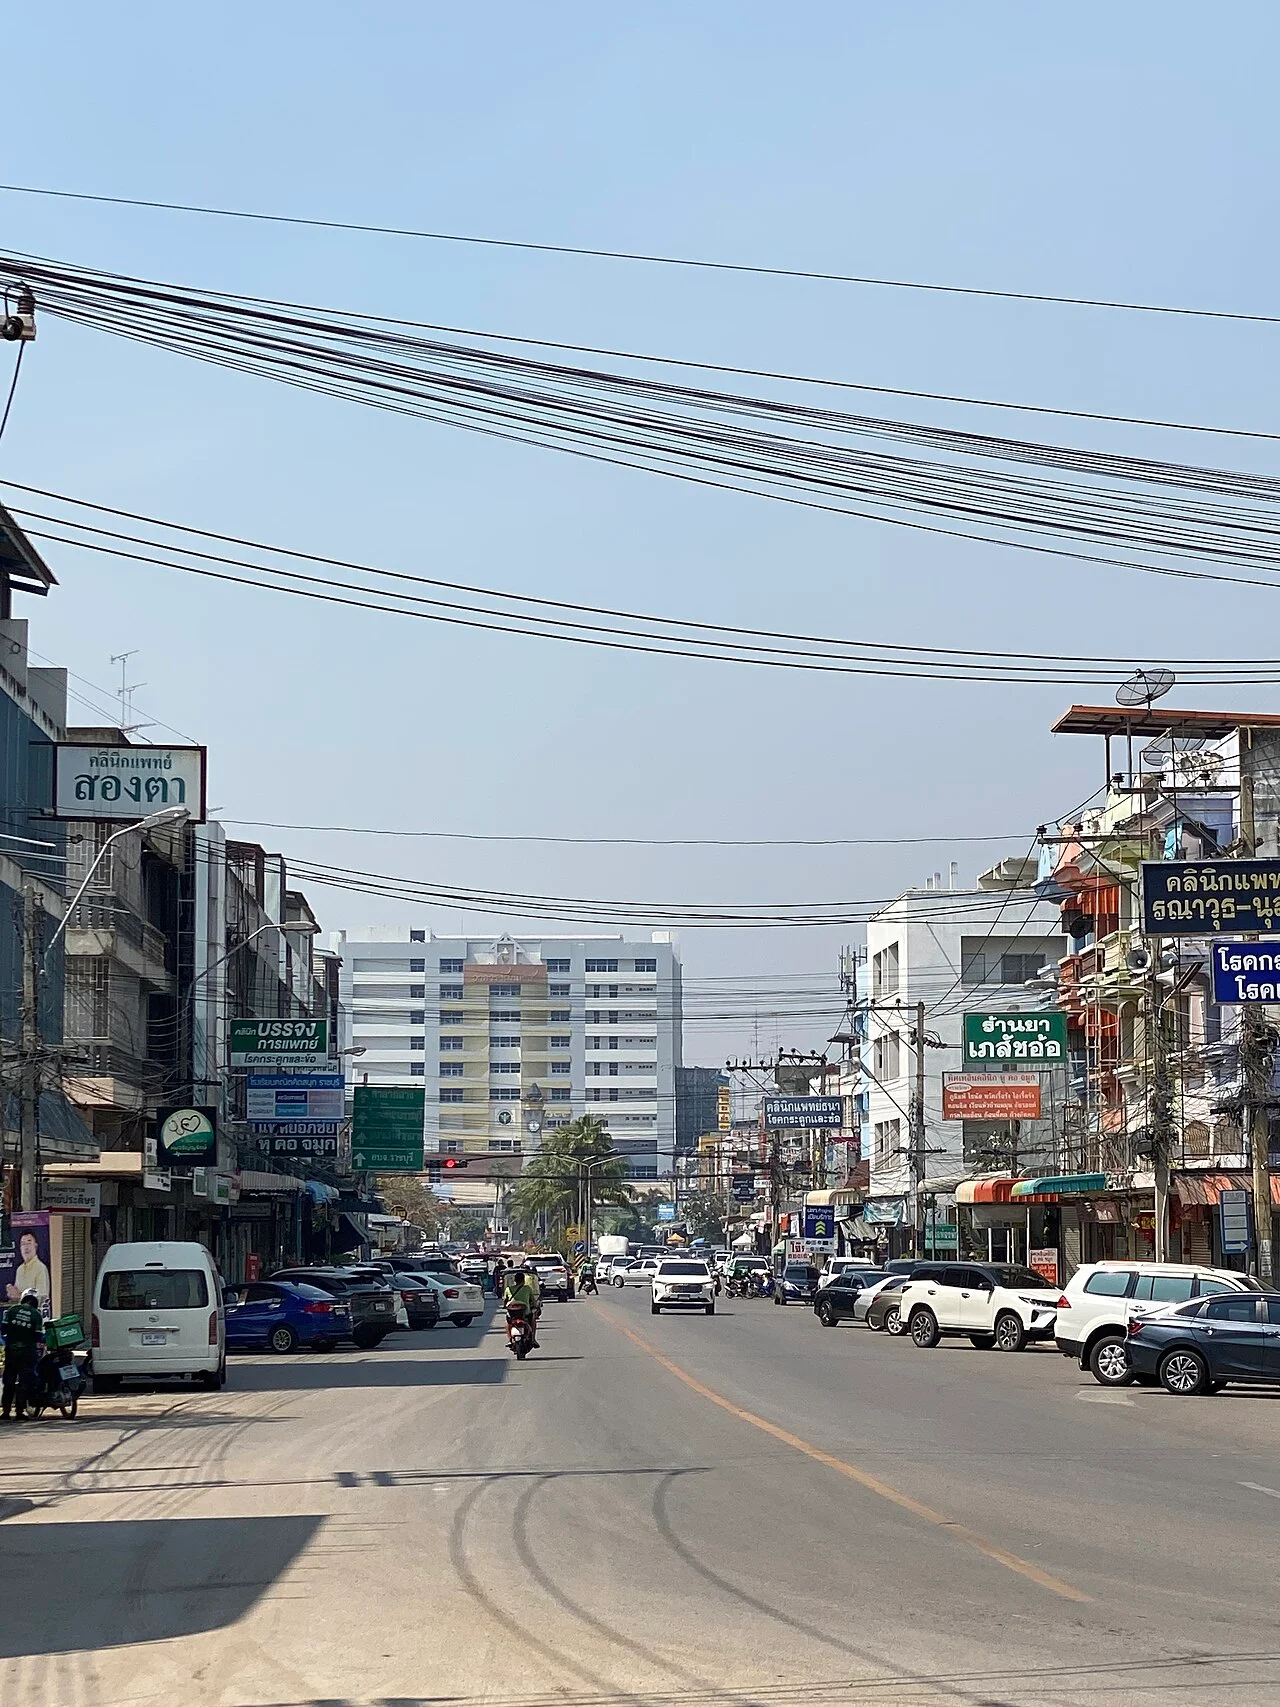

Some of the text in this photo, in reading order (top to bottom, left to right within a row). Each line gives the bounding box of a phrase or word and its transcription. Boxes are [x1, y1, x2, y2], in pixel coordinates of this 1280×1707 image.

[89, 751, 172, 770] คลินิกแพทย์
[74, 774, 186, 804] สองตา
[1235, 975, 1280, 999] โรค
[257, 1022, 316, 1037] บรรจง
[982, 1016, 1050, 1032] ร้านยา
[257, 1036, 320, 1050] การแพทย์
[969, 1034, 1061, 1058] เภสัชอ้อ
[275, 1139, 297, 1150] คอ
[302, 1139, 336, 1156] จมูก
[59, 1328, 78, 1338] Grab
